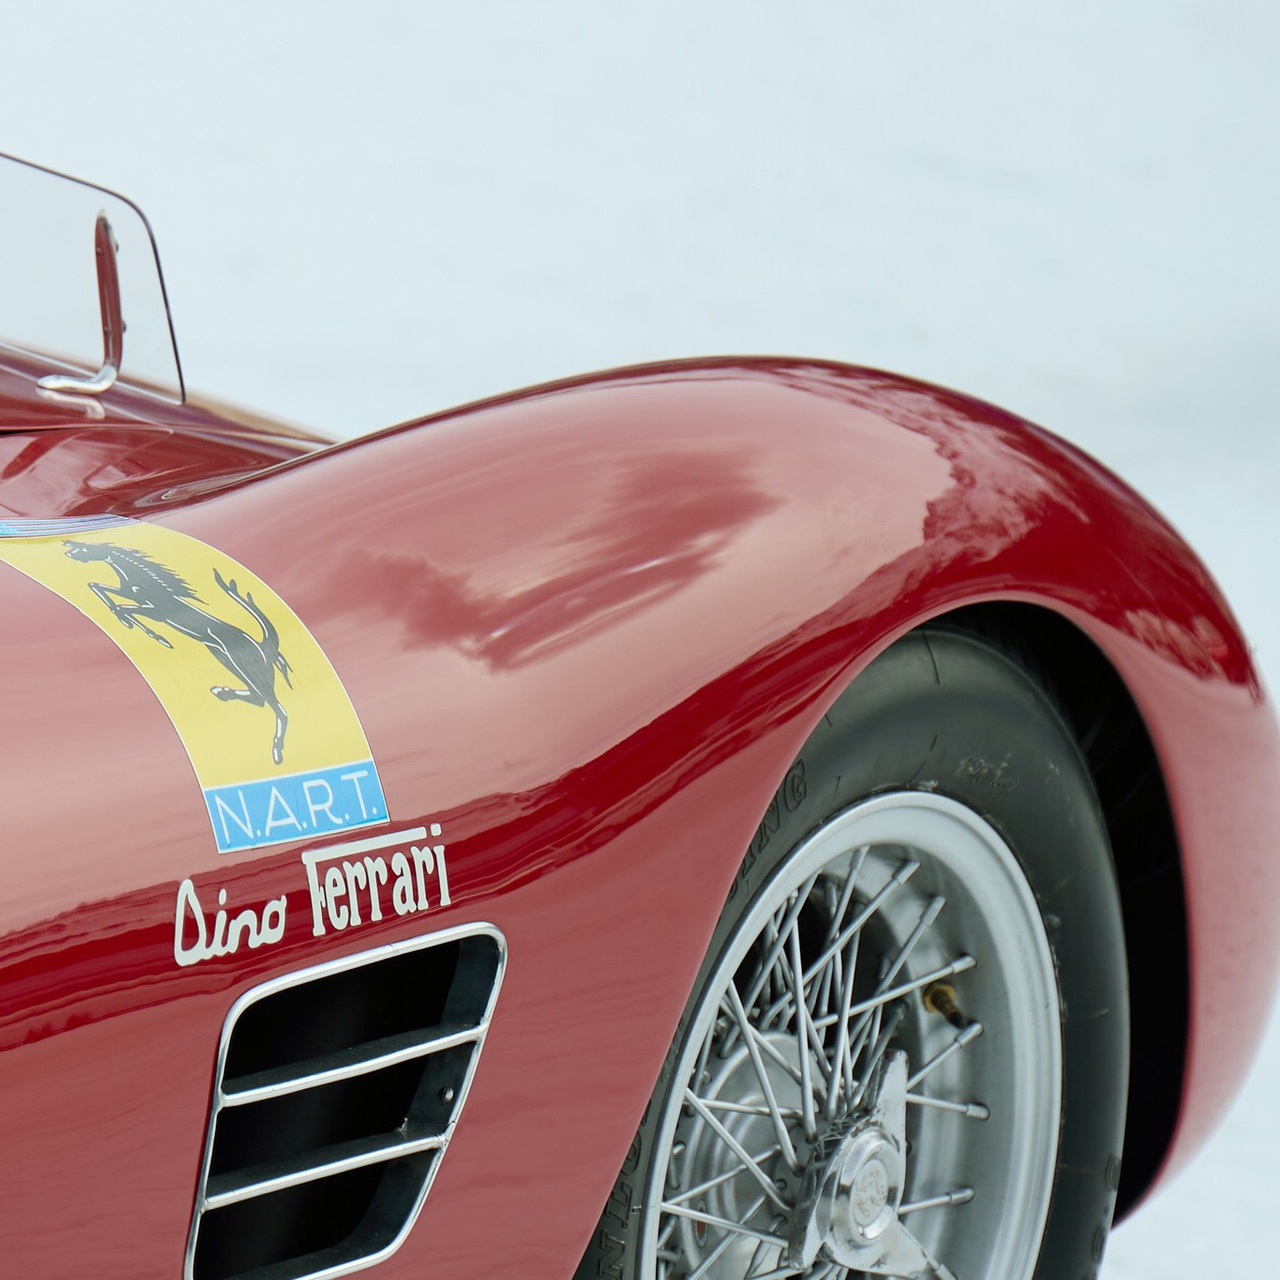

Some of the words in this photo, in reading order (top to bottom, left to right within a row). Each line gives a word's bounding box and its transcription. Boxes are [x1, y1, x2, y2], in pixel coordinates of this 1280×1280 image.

[215, 770, 378, 840] N.A.R.T.
[174, 879, 287, 967] Dino
[301, 824, 451, 938] Ferrari
